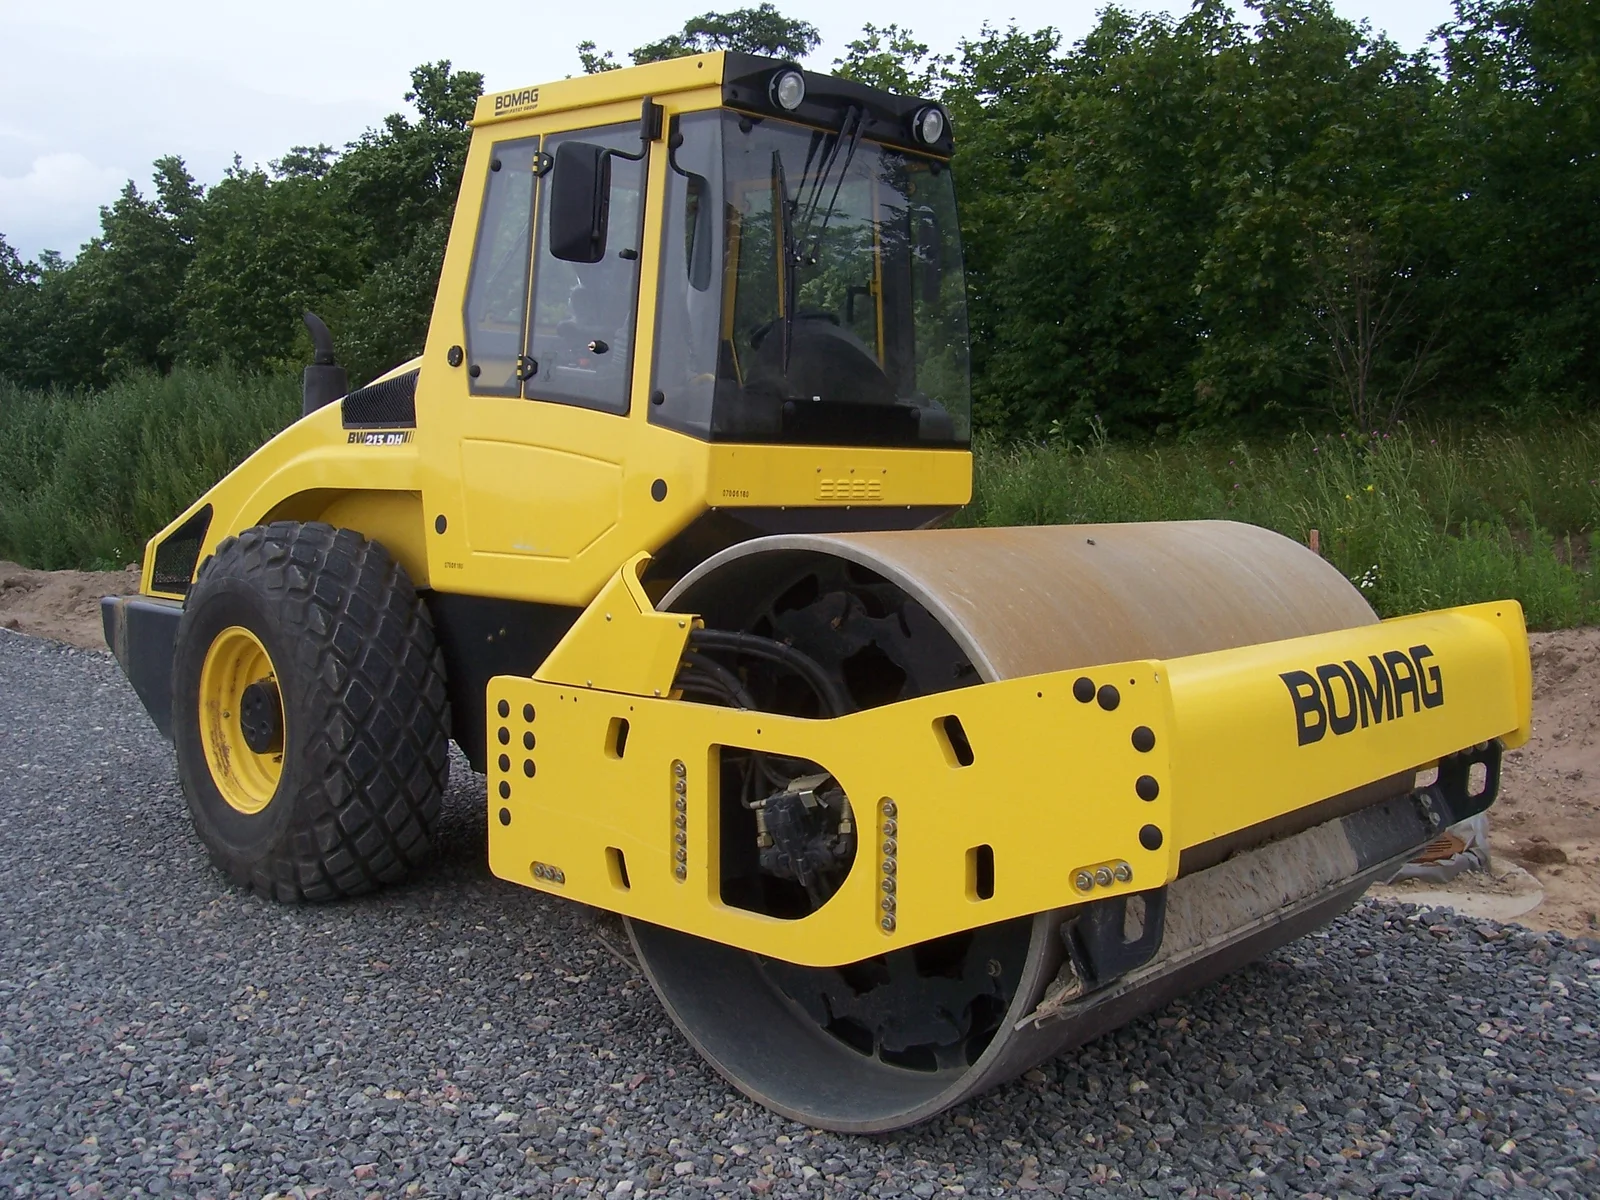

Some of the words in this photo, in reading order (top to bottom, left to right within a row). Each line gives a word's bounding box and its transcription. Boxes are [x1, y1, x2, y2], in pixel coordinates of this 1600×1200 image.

[495, 88, 539, 110] BOMAG
[347, 431, 366, 444] BW
[365, 434, 384, 446] 213
[386, 434, 404, 446] DH
[1278, 644, 1444, 747] BOMAG
